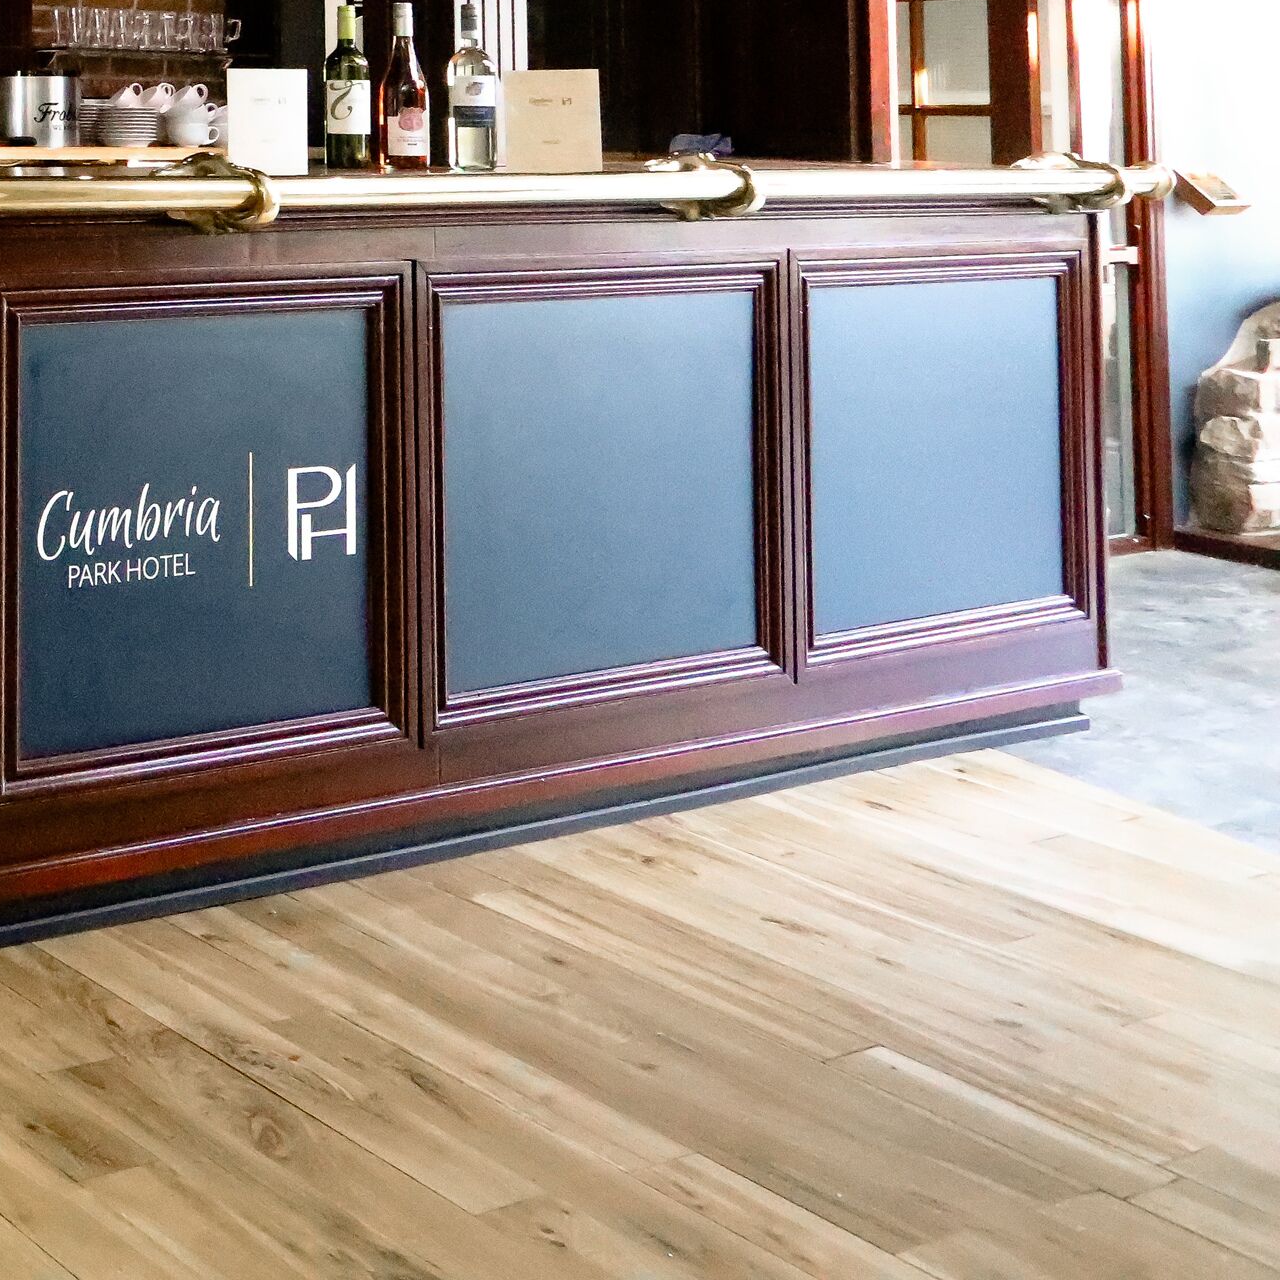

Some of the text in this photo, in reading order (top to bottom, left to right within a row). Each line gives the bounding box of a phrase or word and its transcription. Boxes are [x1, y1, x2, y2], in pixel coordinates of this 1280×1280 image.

[37, 483, 220, 561] Cumbria
[67, 552, 196, 589] PARK HOTEL
